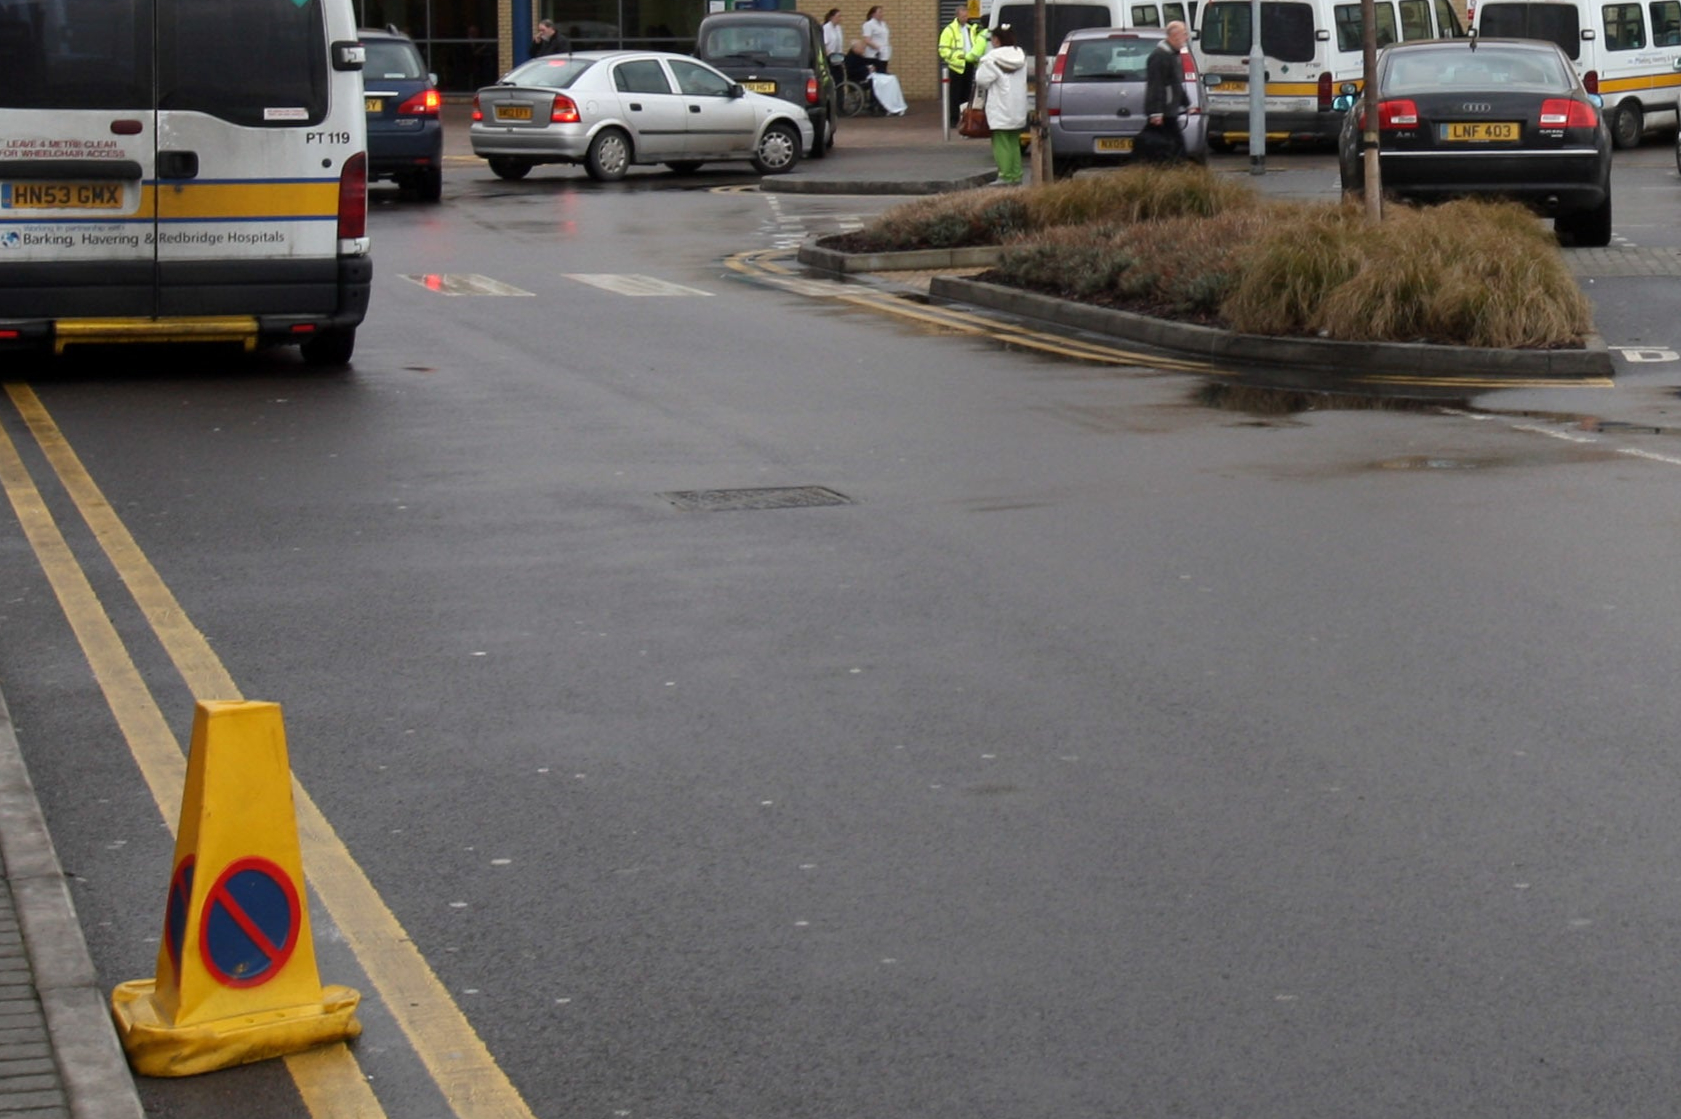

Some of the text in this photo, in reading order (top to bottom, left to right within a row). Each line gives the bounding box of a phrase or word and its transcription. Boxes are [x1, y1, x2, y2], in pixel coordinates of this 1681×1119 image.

[306, 131, 350, 144] PT 119
[1453, 124, 1511, 138] LNF 403
[86, 149, 125, 159] ACCESS
[15, 184, 119, 204] HN53 GMX
[23, 231, 285, 248] Barking, Havering & Redbridge Hospitals
